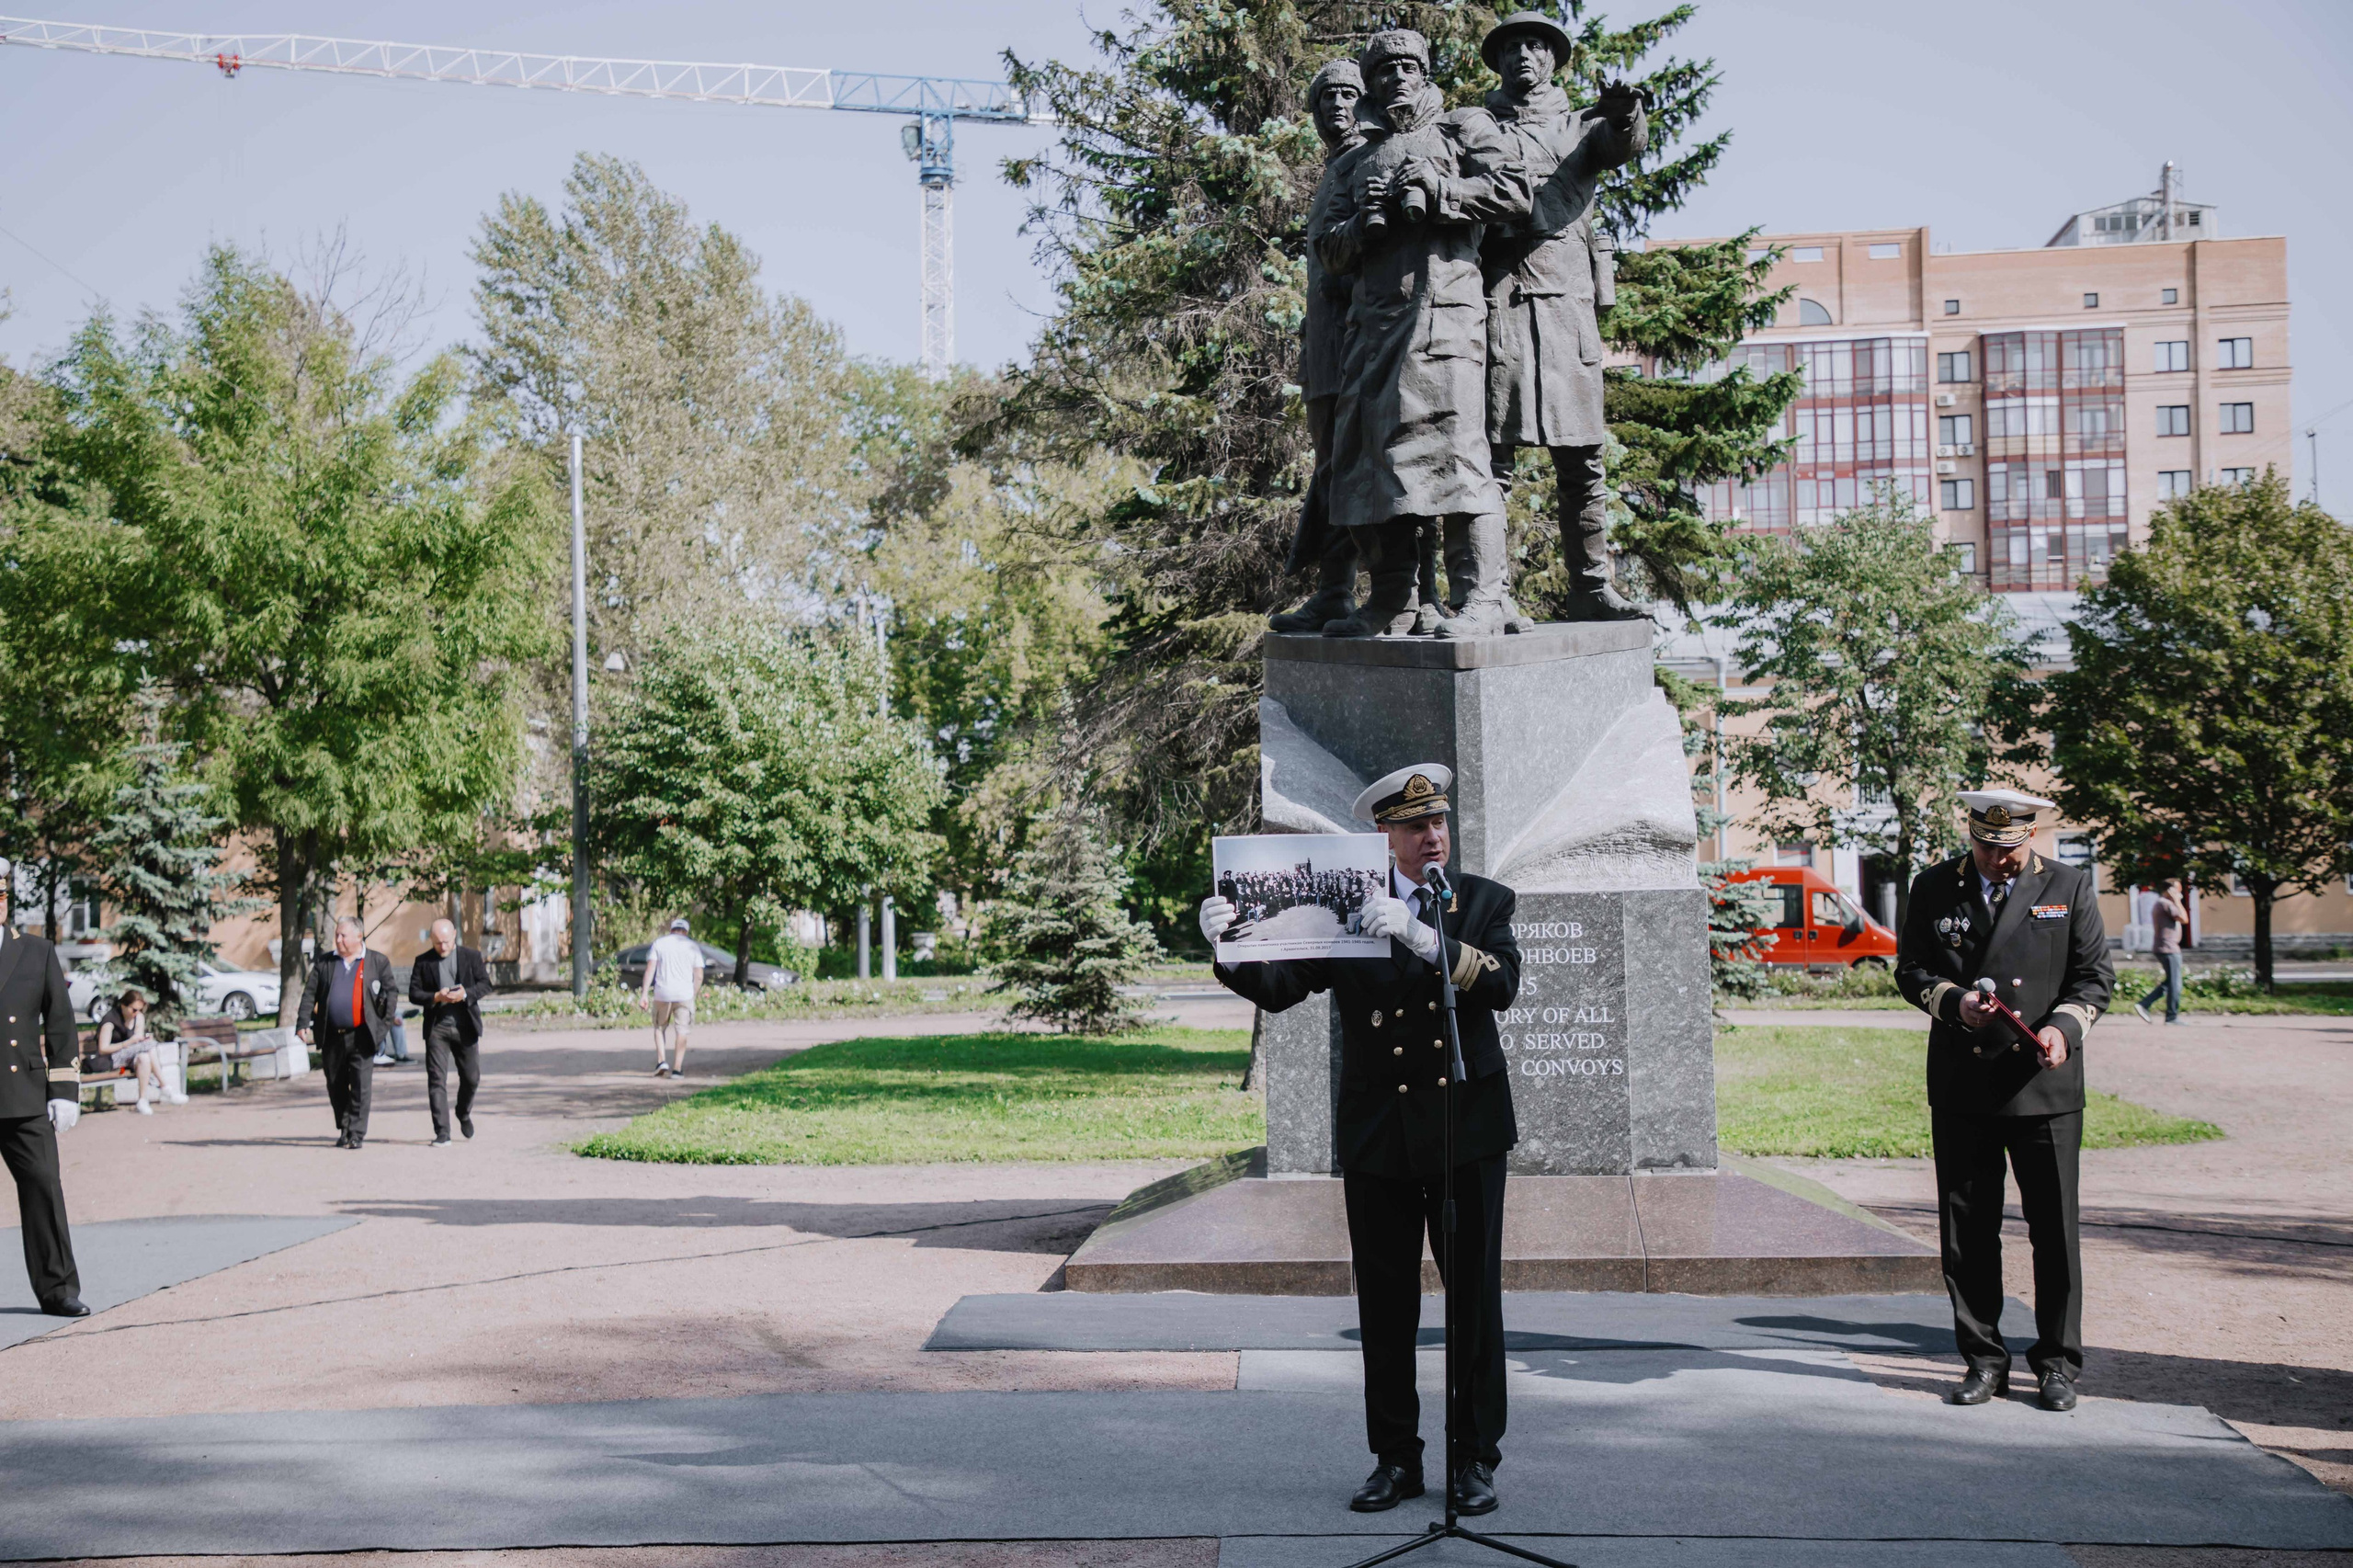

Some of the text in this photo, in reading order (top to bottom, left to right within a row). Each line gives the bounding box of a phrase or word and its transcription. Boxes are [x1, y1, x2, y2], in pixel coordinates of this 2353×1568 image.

[1509, 922, 1584, 938] РЯКОВ
[1518, 948, 1597, 963] НВОЕВ
[1495, 1006, 1616, 1024] ORY OF ALL
[1525, 1033, 1605, 1050] SERVED
[1521, 1059, 1624, 1075] CONVOYS
